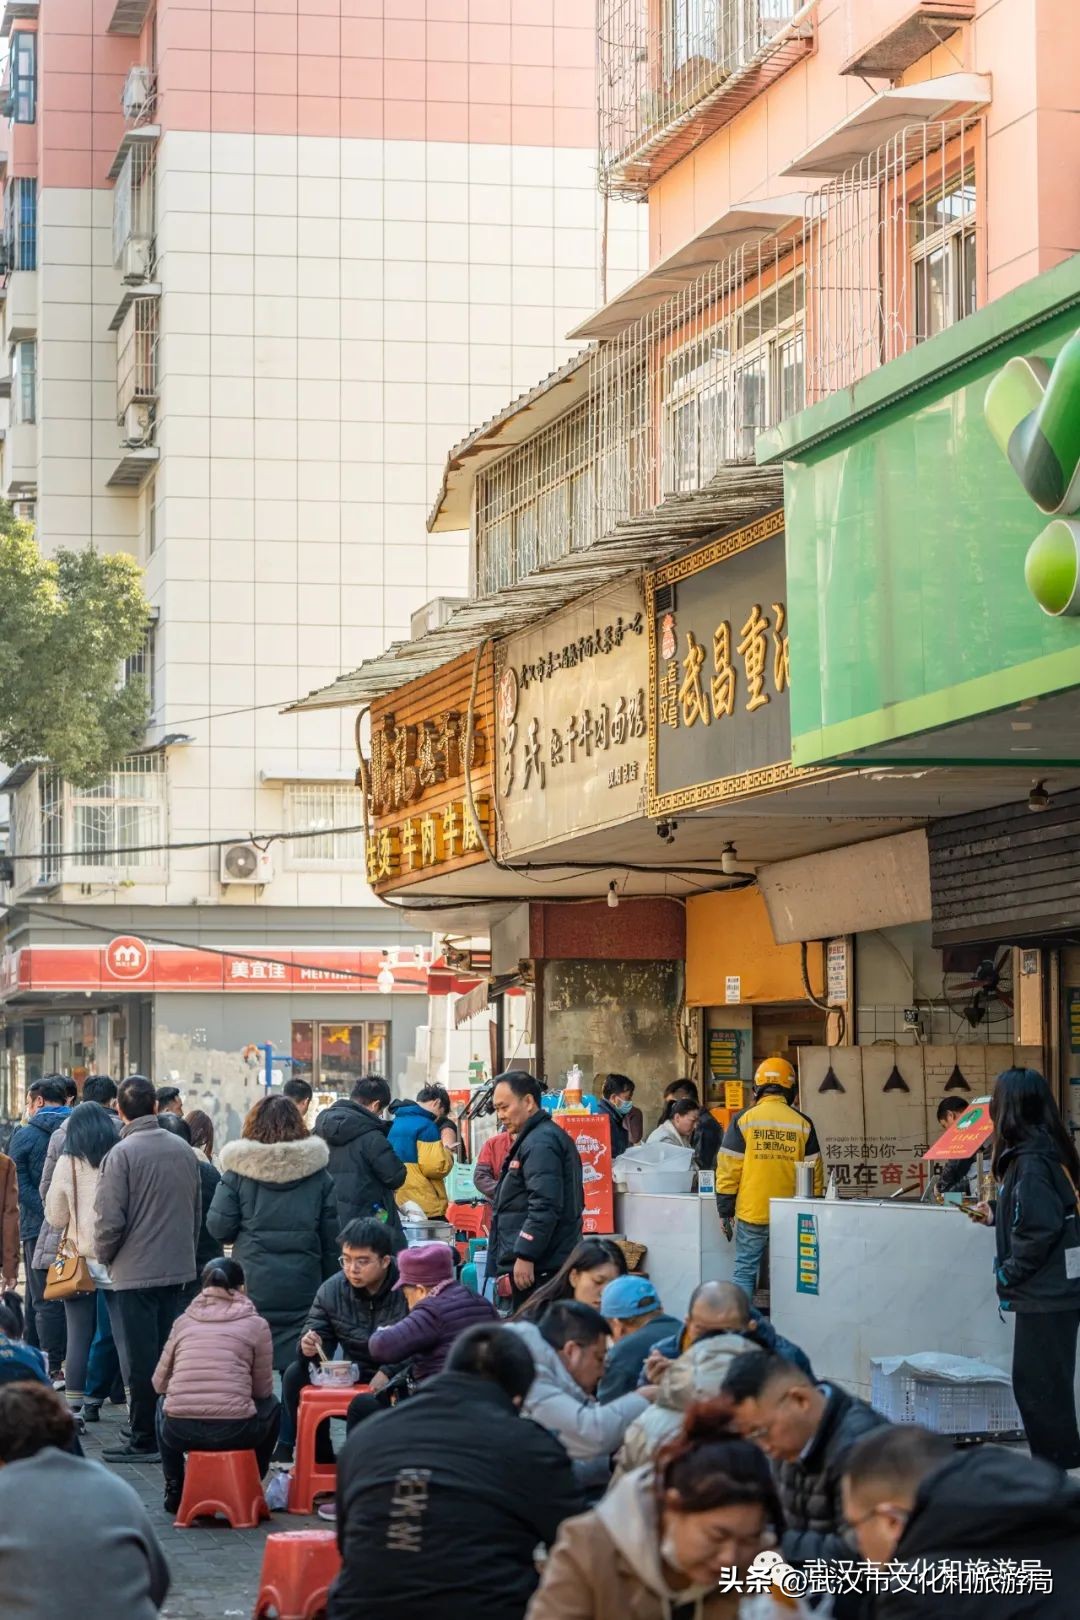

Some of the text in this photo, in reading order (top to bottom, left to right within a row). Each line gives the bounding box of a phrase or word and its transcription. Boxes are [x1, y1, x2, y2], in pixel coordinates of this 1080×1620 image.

[231, 961, 286, 979] 美宜佳
[753, 1129, 797, 1142] 到店吃喝
[753, 1142, 796, 1154] 上美团App
[826, 1143, 930, 1160] 将来的你一定
